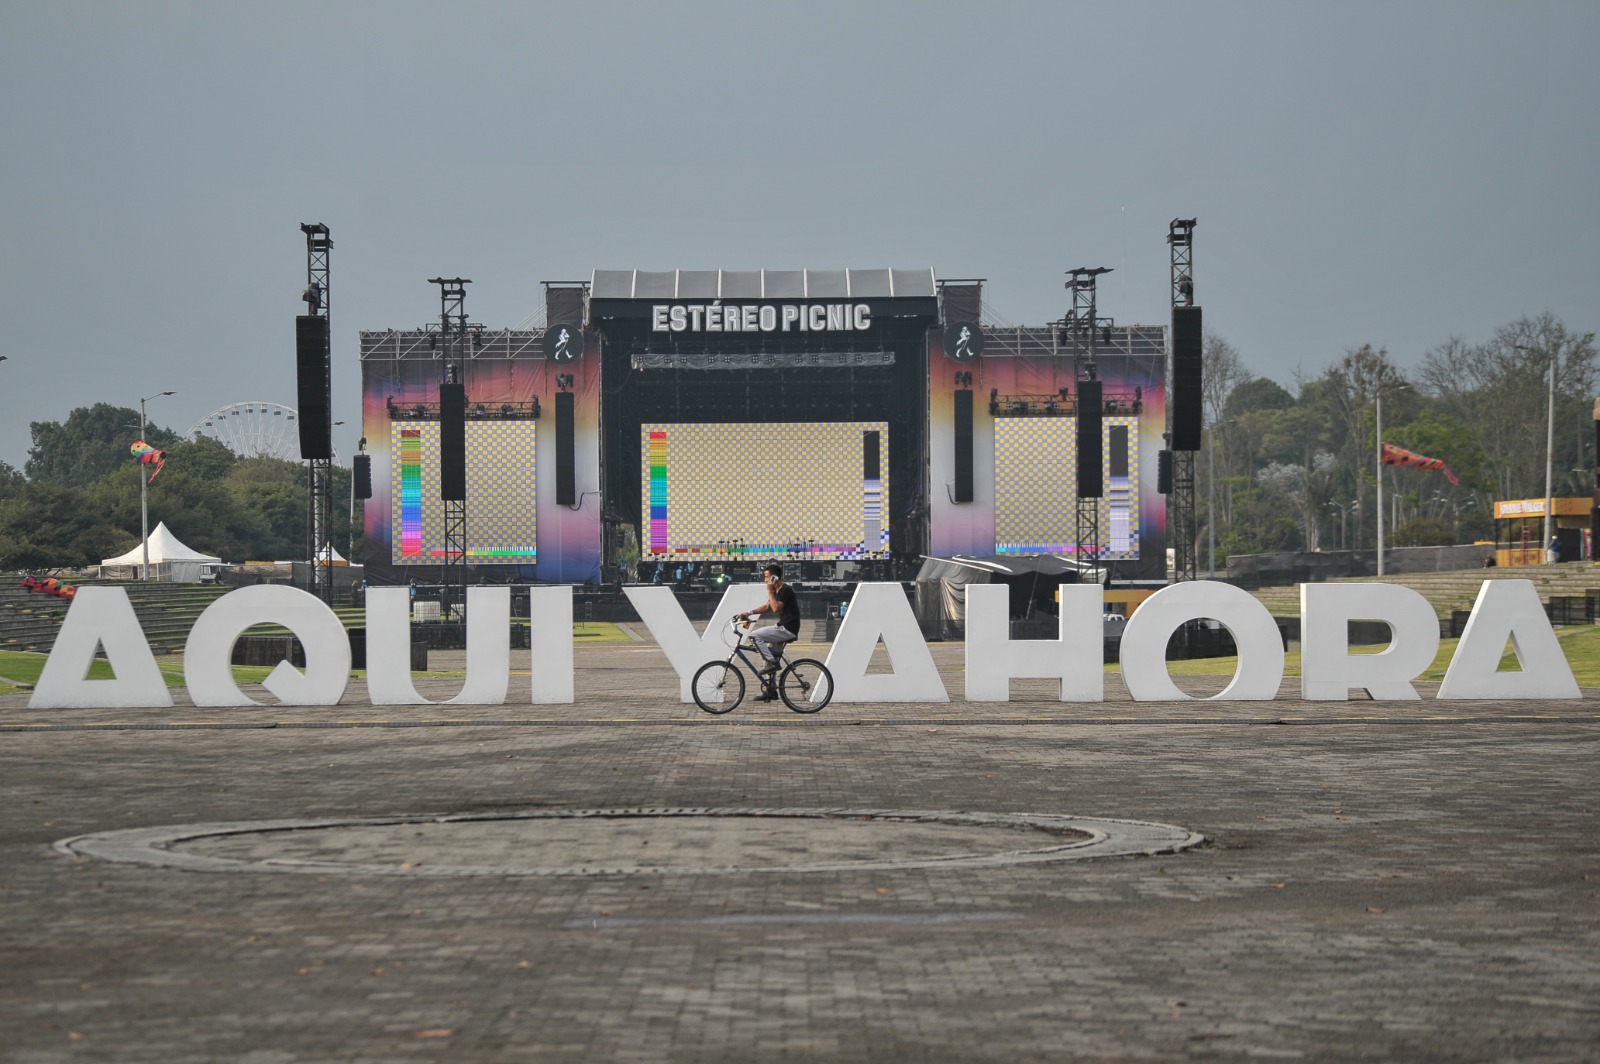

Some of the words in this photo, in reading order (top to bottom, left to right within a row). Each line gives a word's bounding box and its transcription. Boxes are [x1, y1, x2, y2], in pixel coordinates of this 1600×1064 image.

[652, 300, 777, 332] ESTÉREO
[782, 304, 871, 332] PICNIC
[27, 583, 574, 709] AQUI
[622, 582, 770, 704] Y
[809, 579, 1583, 703] AHORA
